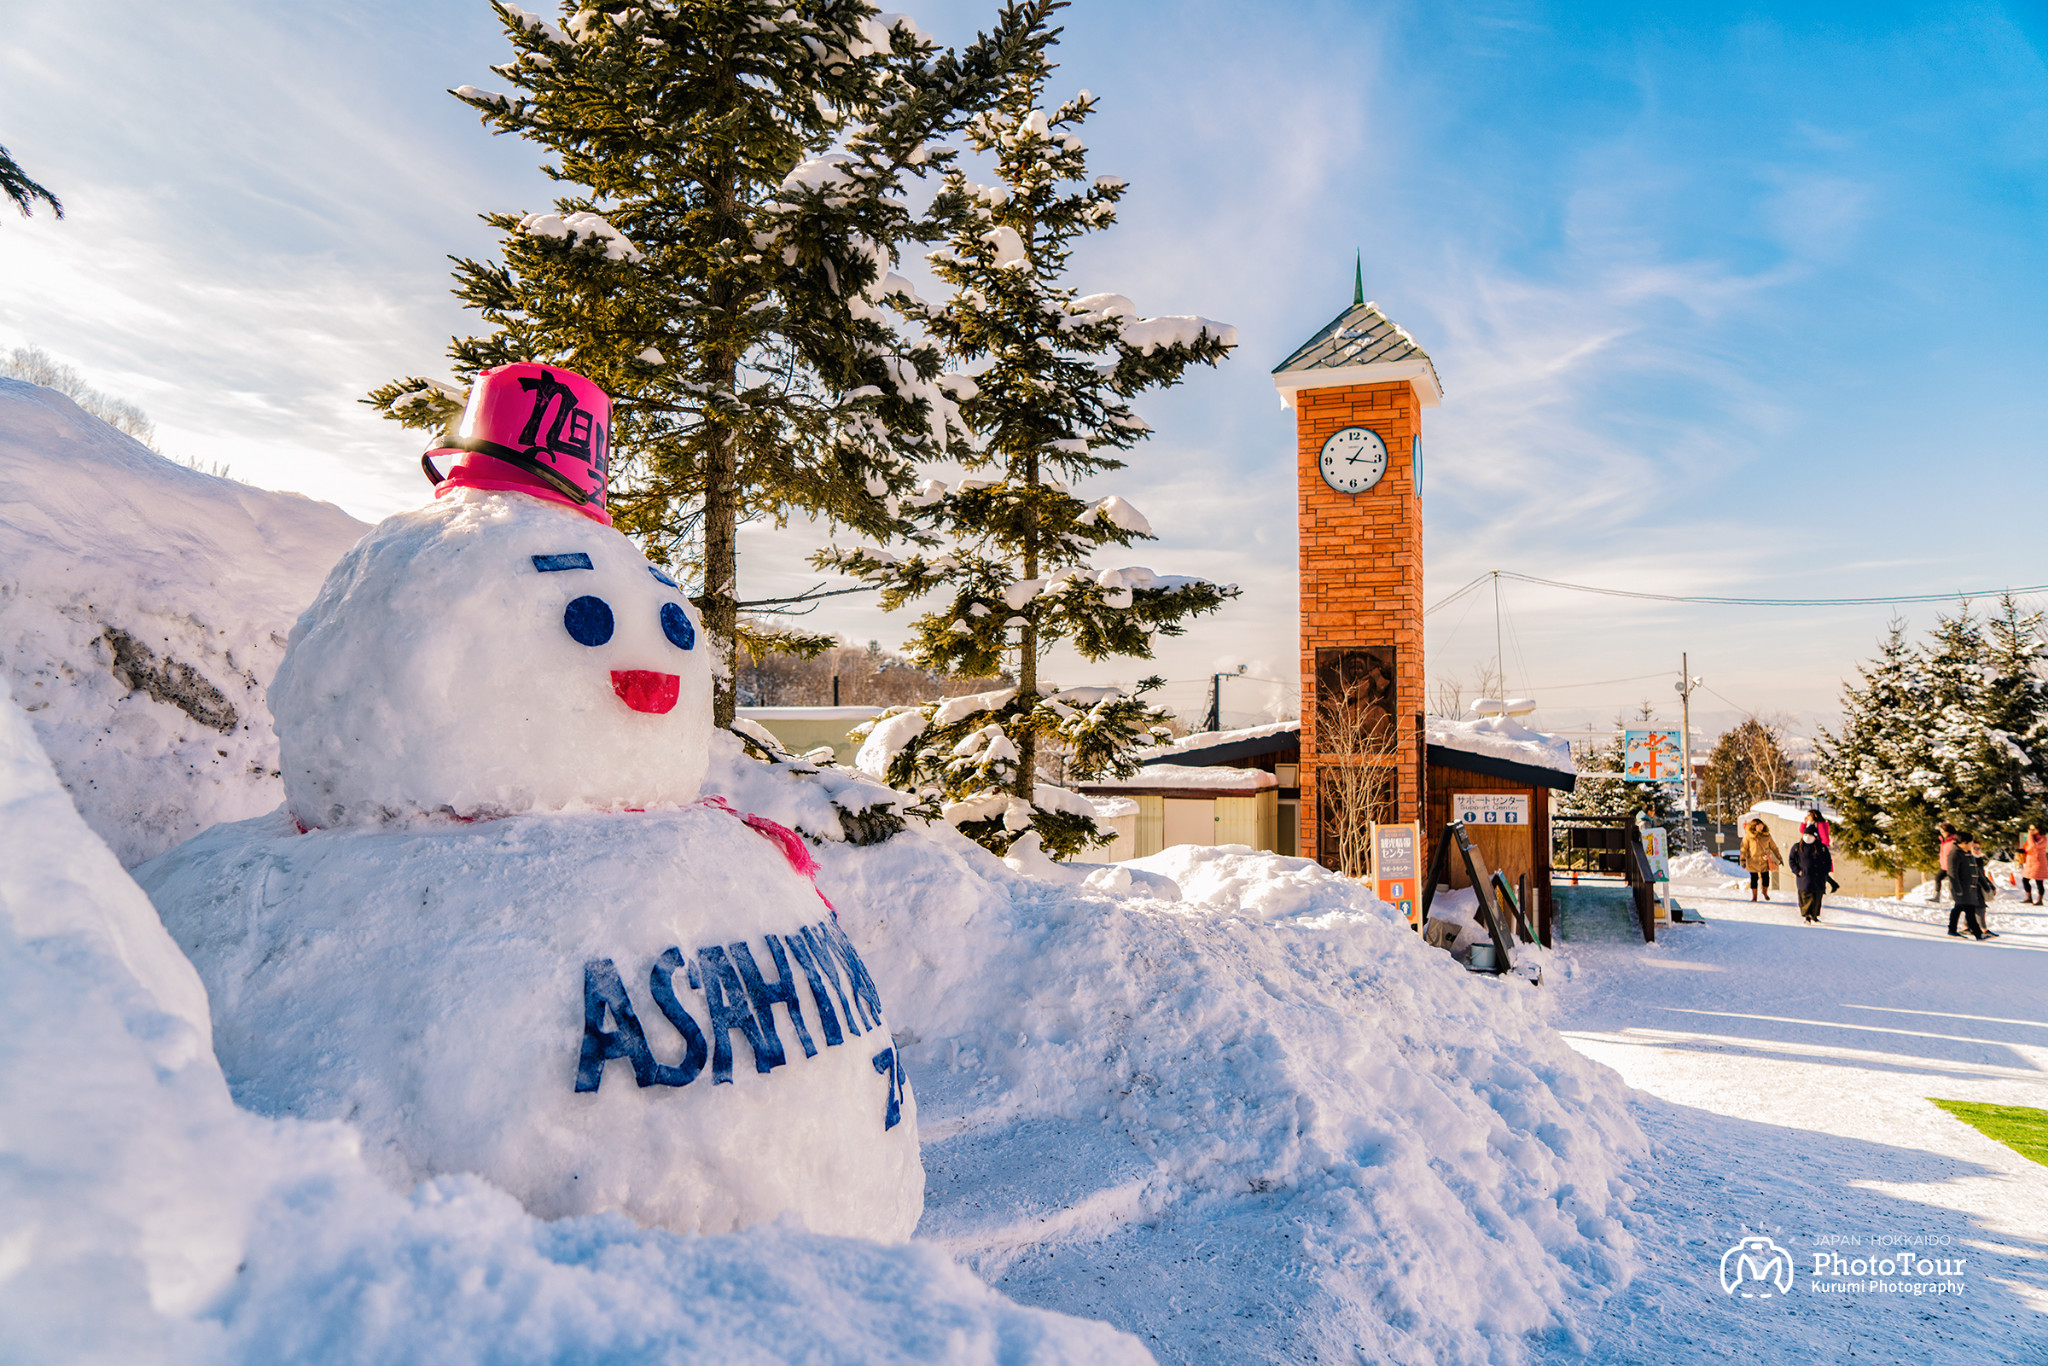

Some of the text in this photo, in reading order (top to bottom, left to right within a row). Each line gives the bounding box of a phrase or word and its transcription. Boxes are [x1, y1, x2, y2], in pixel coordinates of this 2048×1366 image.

[1349, 432, 1360, 441] 12
[1325, 454, 1382, 466] 9 3
[1349, 479, 1358, 488] 6
[1457, 795, 1526, 805] サポートセンター
[1382, 848, 1411, 859] センター
